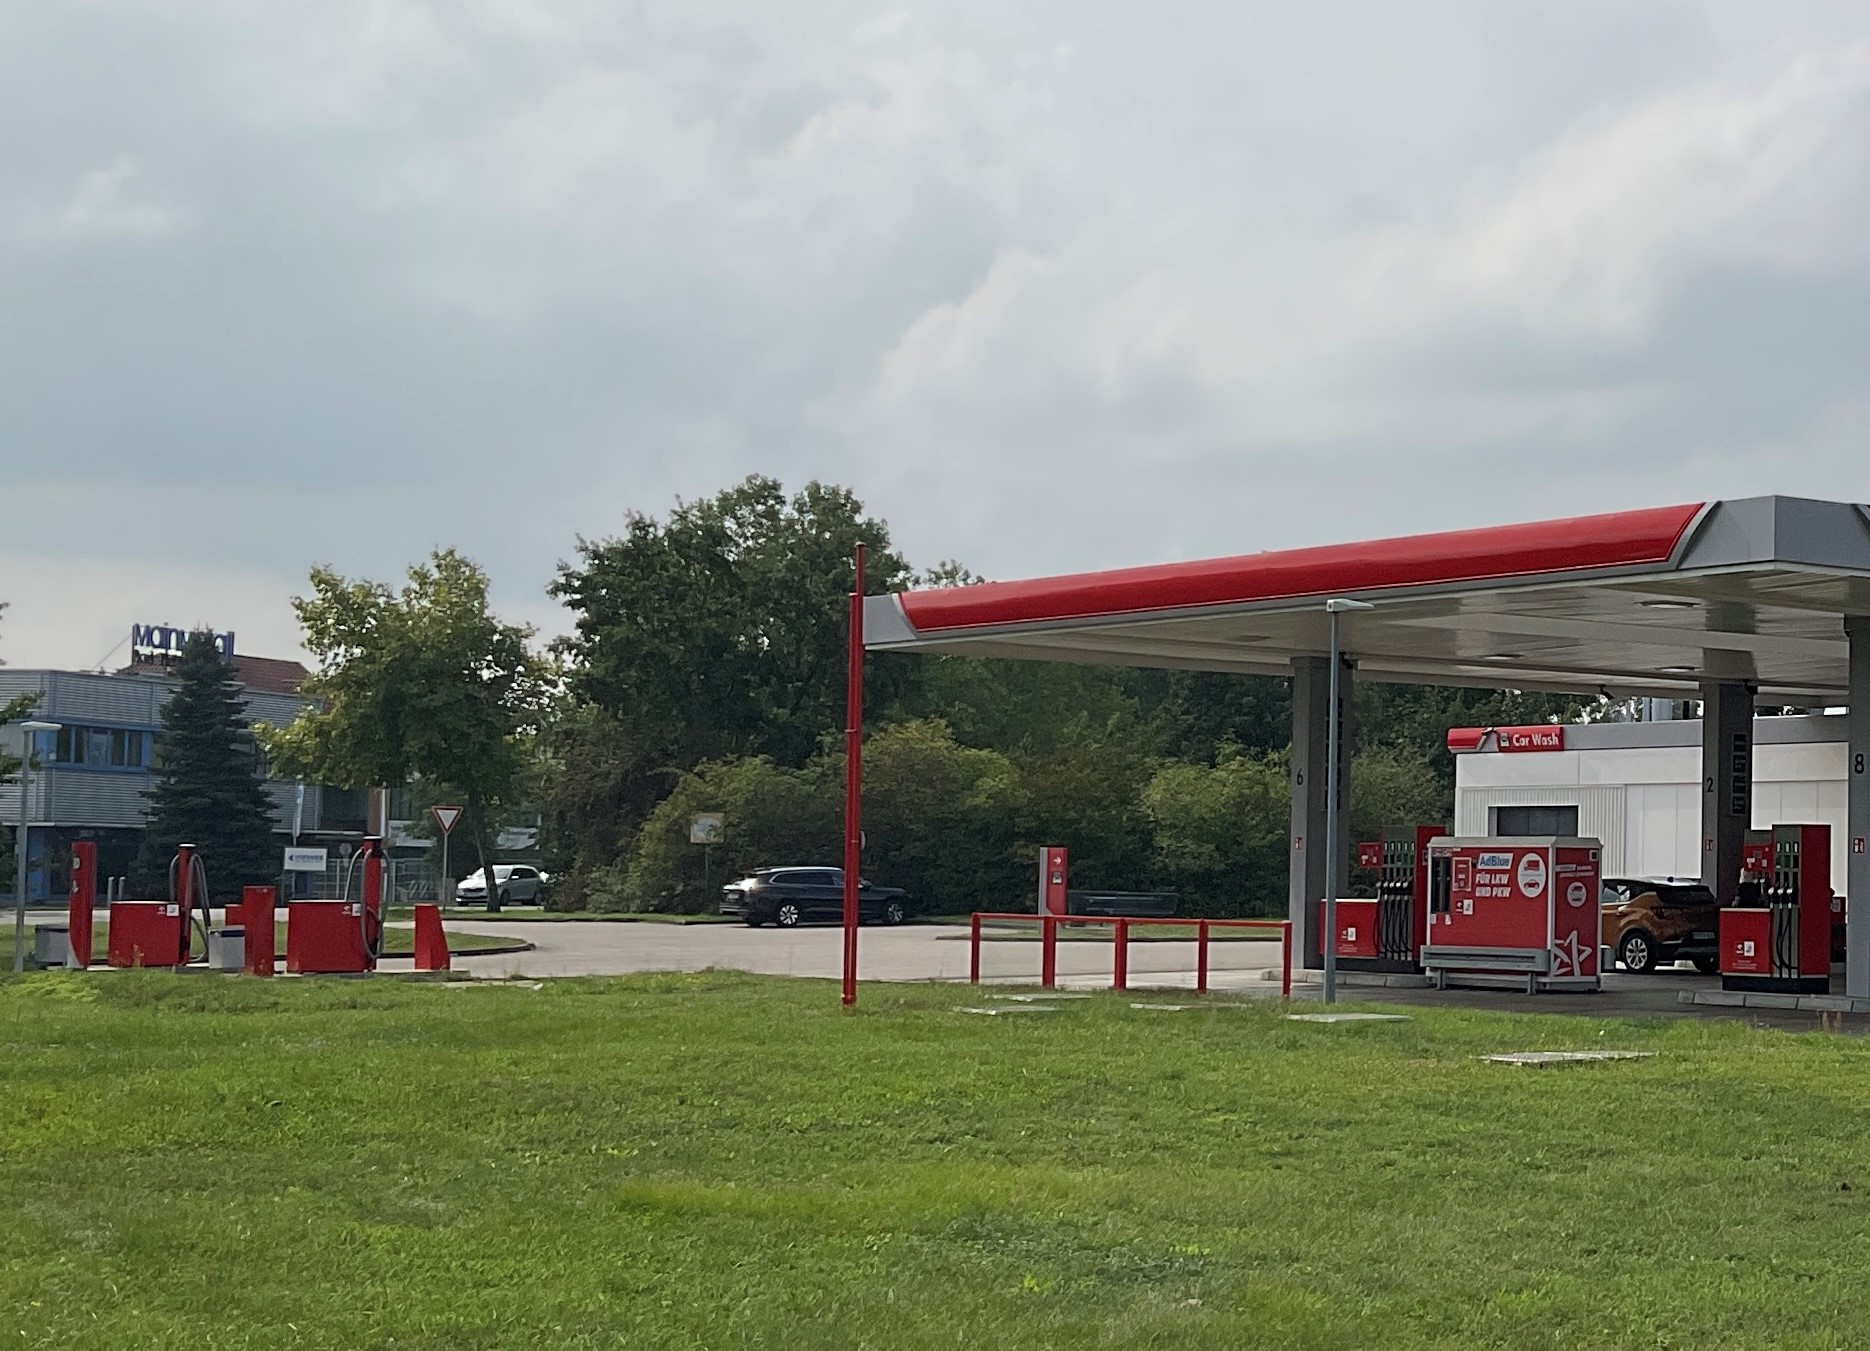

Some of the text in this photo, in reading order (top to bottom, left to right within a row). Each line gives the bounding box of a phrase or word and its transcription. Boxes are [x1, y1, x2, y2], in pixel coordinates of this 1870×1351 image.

[1513, 732, 1559, 746] Car Wash
[1854, 753, 1865, 774] 8
[1296, 768, 1304, 786] 6
[1706, 777, 1714, 793] 2
[1479, 855, 1510, 867] AdBlue
[1475, 872, 1509, 884] FÜR LKW
[1492, 886, 1511, 897] PKW
